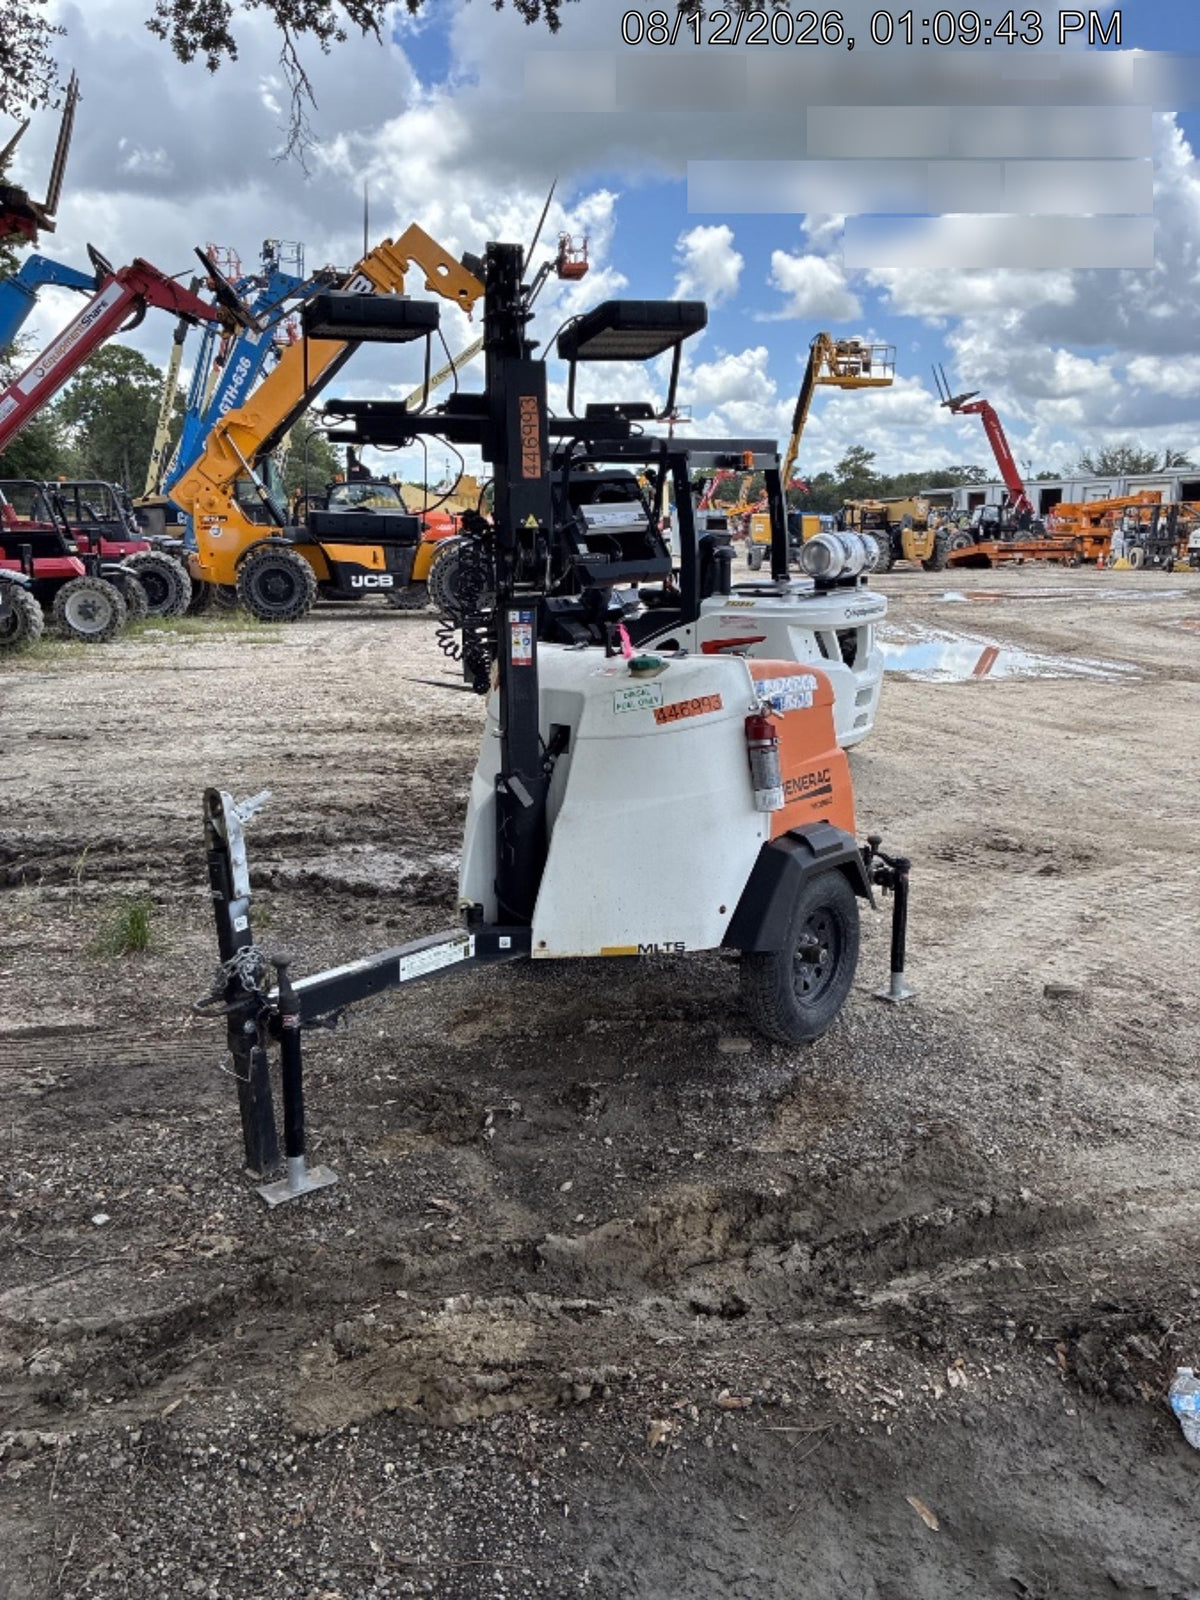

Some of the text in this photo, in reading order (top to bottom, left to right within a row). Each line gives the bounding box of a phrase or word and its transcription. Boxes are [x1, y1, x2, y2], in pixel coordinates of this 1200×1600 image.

[217, 356, 252, 415] GTH-636
[520, 398, 540, 476] 446993
[351, 575, 394, 588] JCB
[656, 696, 722, 721] 446993
